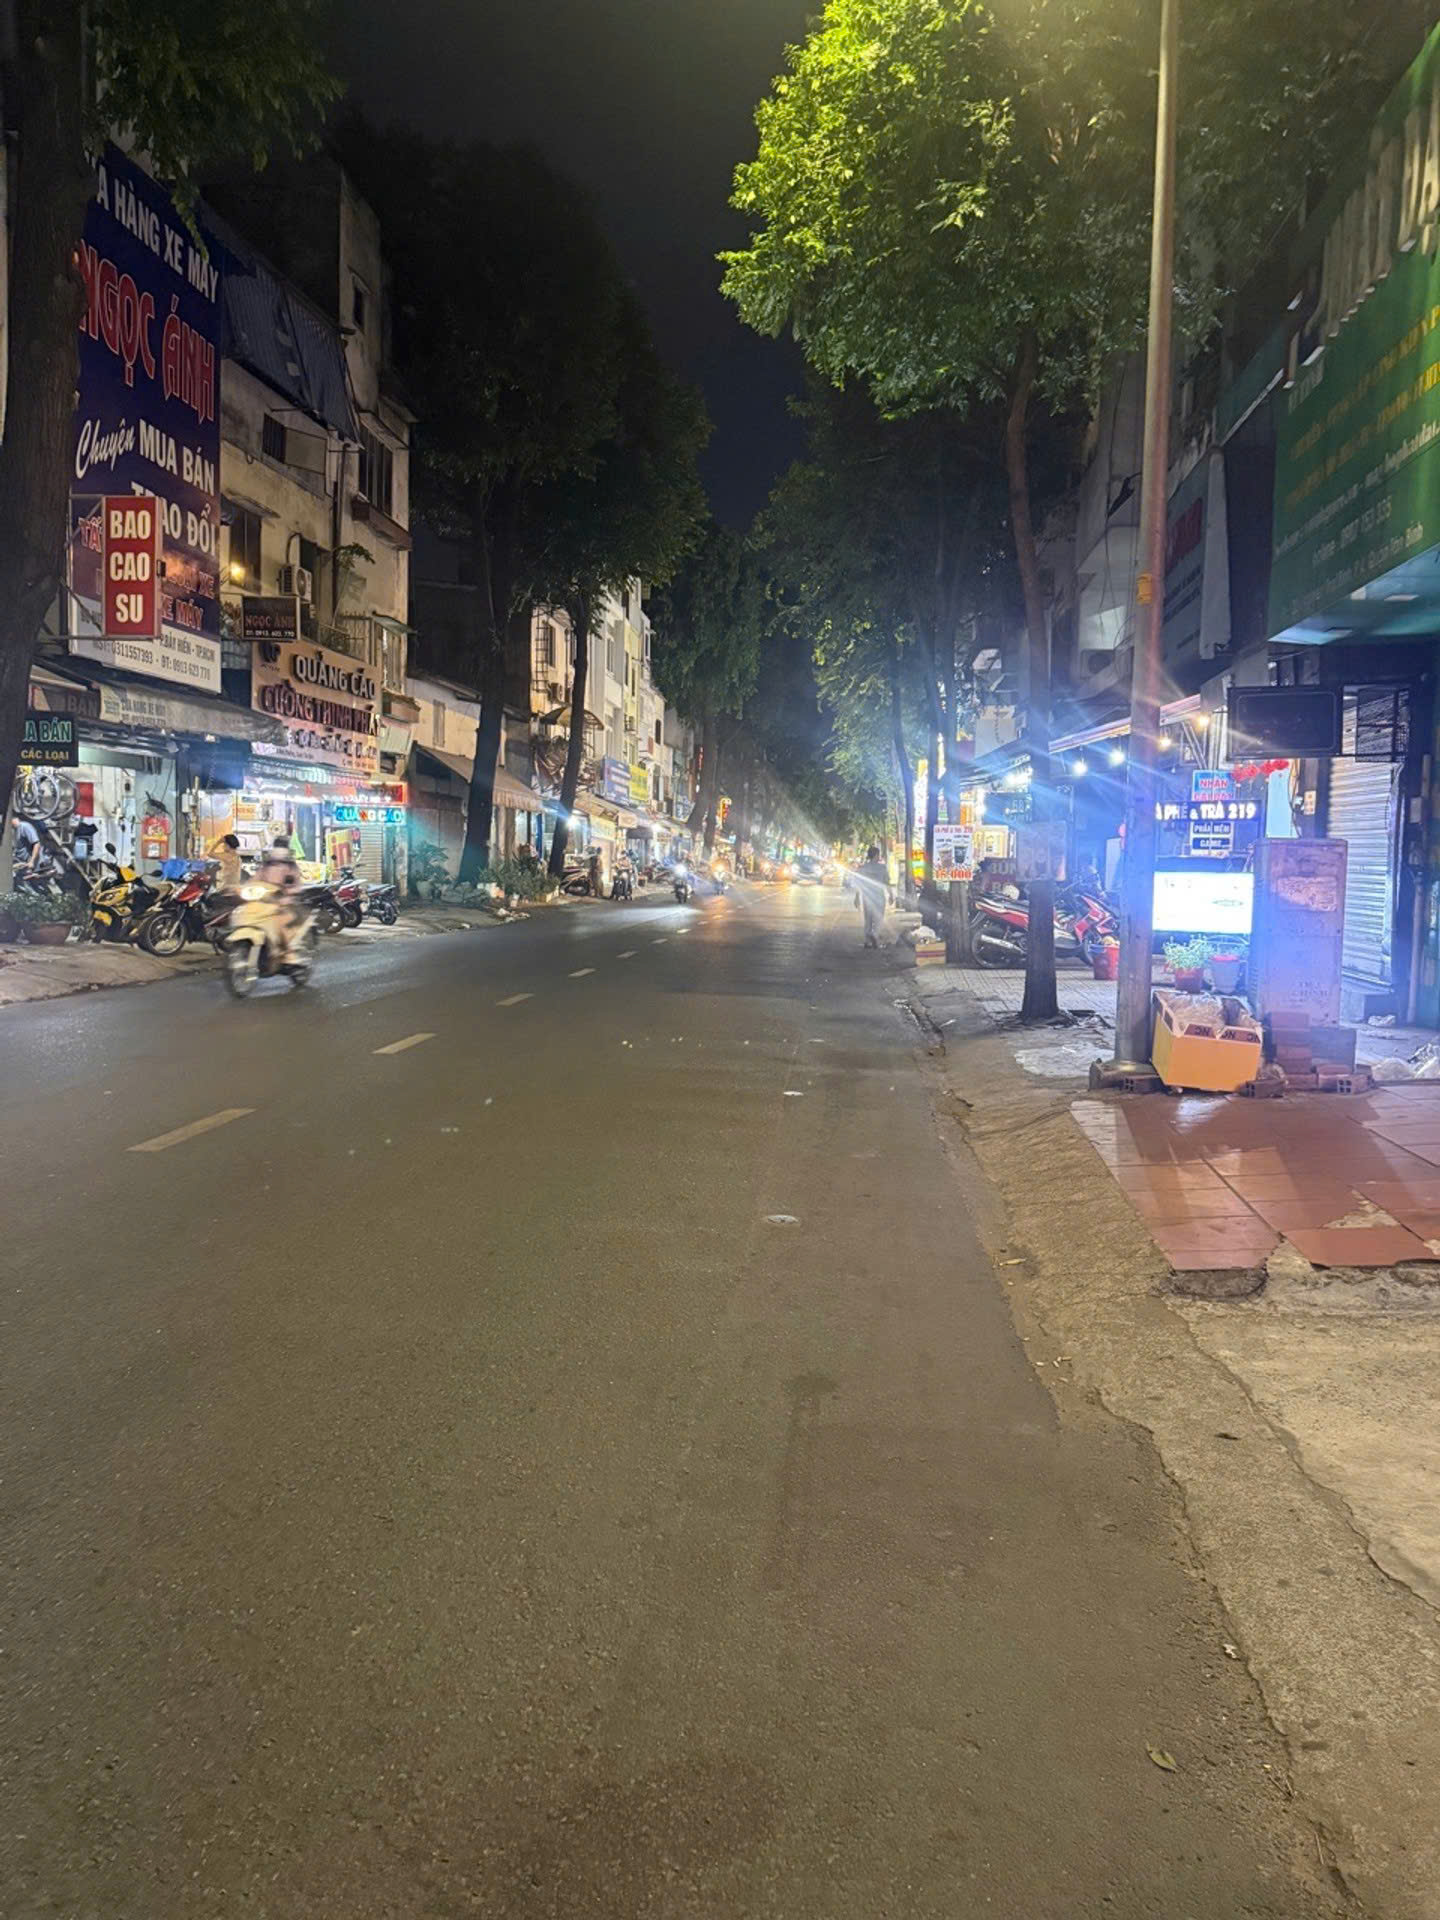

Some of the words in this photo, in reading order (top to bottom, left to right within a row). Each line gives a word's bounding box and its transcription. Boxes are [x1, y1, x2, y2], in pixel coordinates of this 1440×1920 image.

[114, 177, 161, 257] HÀNG
[163, 223, 184, 276] XE
[78, 238, 156, 388] NGỌC
[162, 293, 216, 425] ÁNH
[75, 417, 136, 480] Chuyên
[139, 418, 178, 476] MUA
[182, 446, 216, 497] BÁN
[110, 510, 151, 540] BAO
[186, 502, 217, 557] ĐỔI
[110, 551, 151, 582] CAO
[199, 570, 215, 600] XE
[115, 592, 144, 624] SU
[175, 598, 204, 631] MÁY
[39, 716, 72, 743] BÁN
[20, 747, 43, 760] CÁC
[46, 750, 69, 763] LOẠI
[1190, 808, 1199, 820] &
[1200, 801, 1225, 820] TRÀ
[1228, 802, 1256, 820] 219
